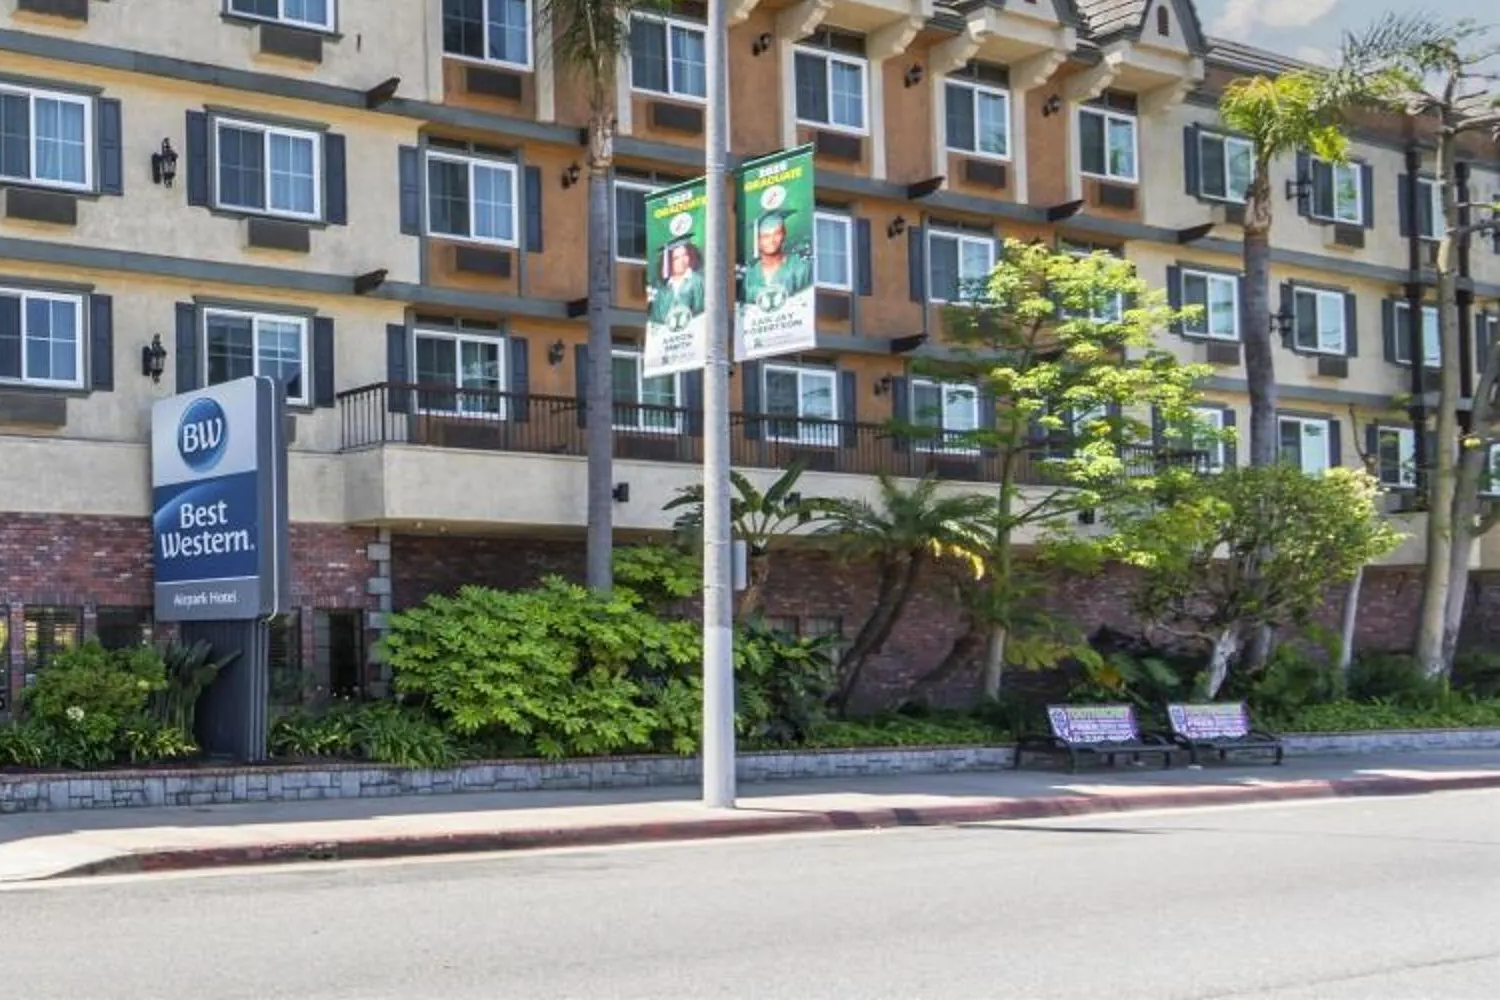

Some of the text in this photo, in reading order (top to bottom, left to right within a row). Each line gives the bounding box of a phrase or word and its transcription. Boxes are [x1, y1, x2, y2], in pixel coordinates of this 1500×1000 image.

[183, 419, 221, 453] BW
[180, 501, 228, 528] Best
[174, 590, 237, 611] Airpark Hotel
